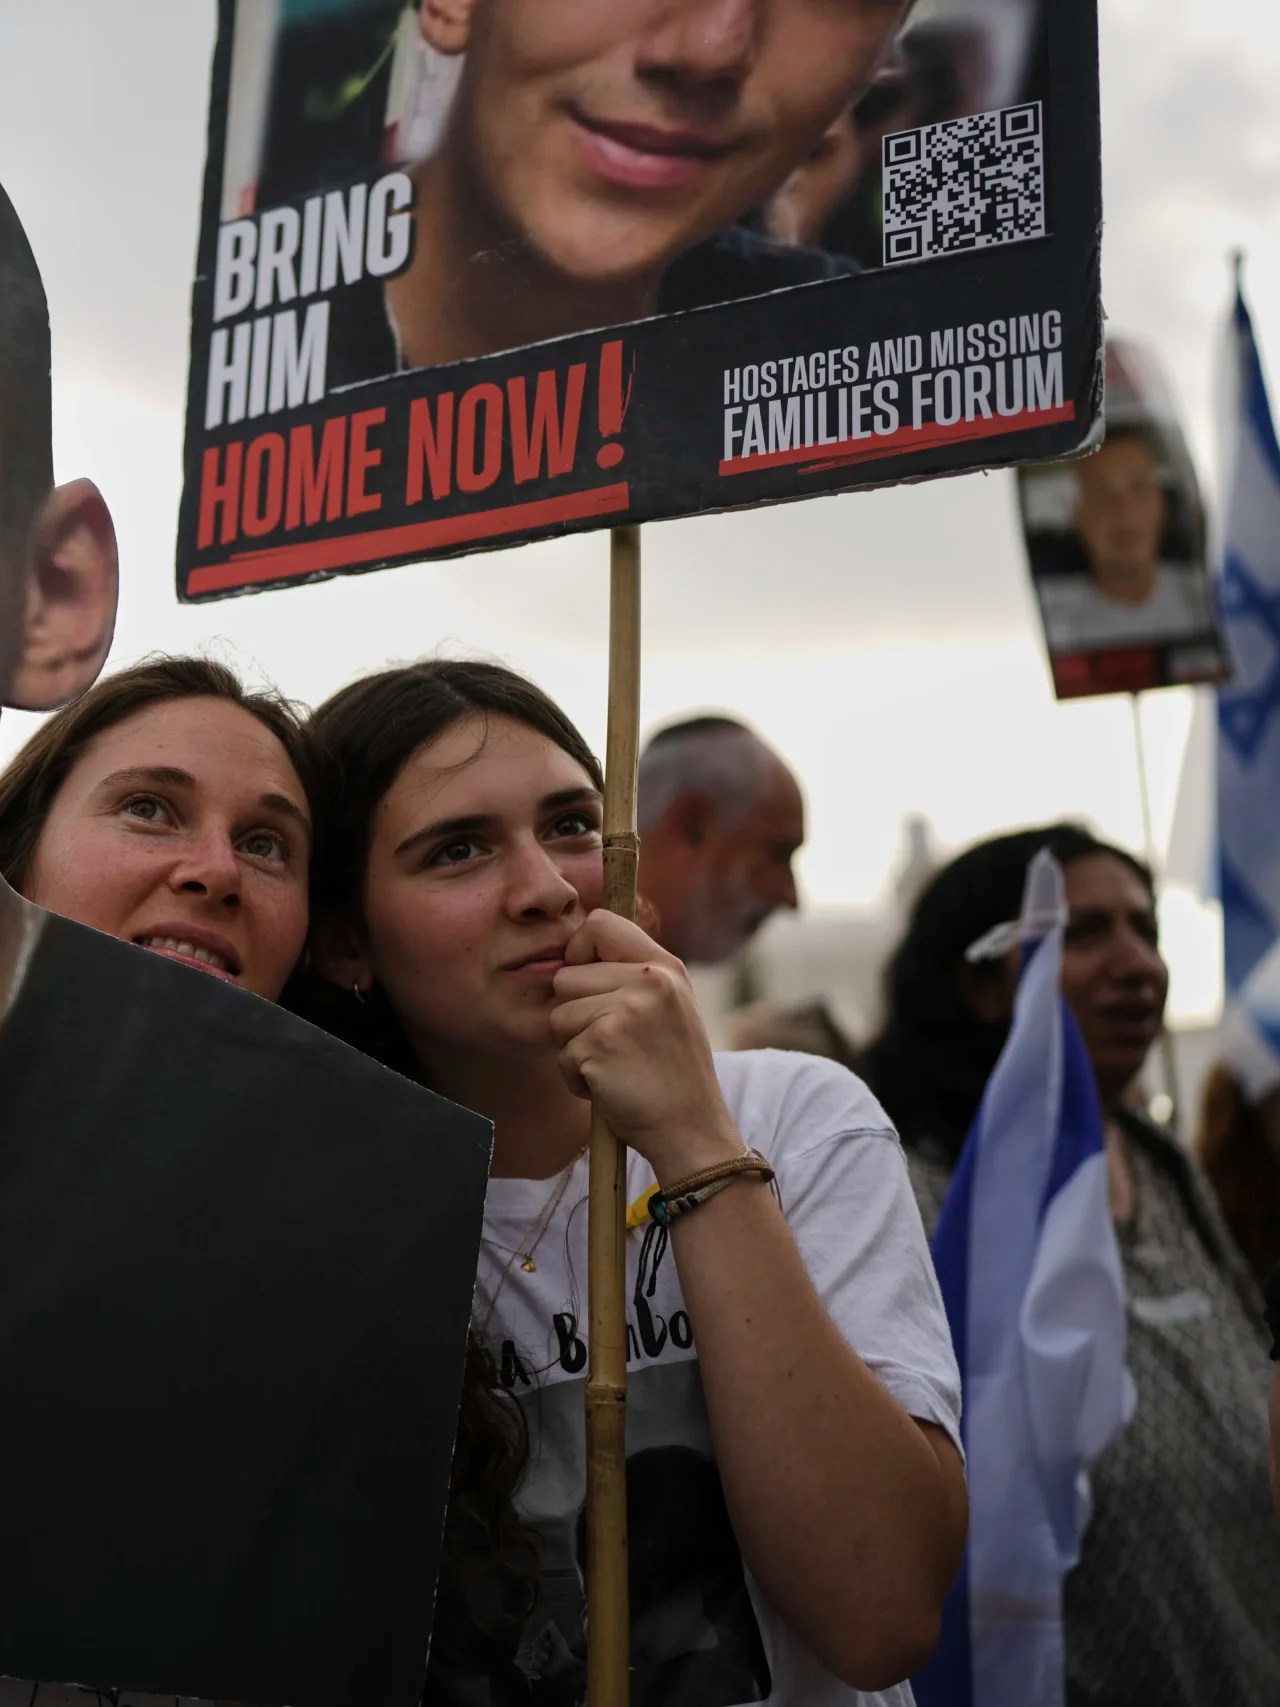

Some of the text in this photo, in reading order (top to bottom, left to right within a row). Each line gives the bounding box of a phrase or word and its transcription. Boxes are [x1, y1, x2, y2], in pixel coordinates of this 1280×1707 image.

[213, 172, 413, 323] BRING
[204, 301, 330, 430] HIM
[723, 310, 1062, 405] HOSTAGES AND MISSING
[723, 351, 1064, 461] FAMILIES FORUM
[197, 340, 629, 550] HOME NOW!
